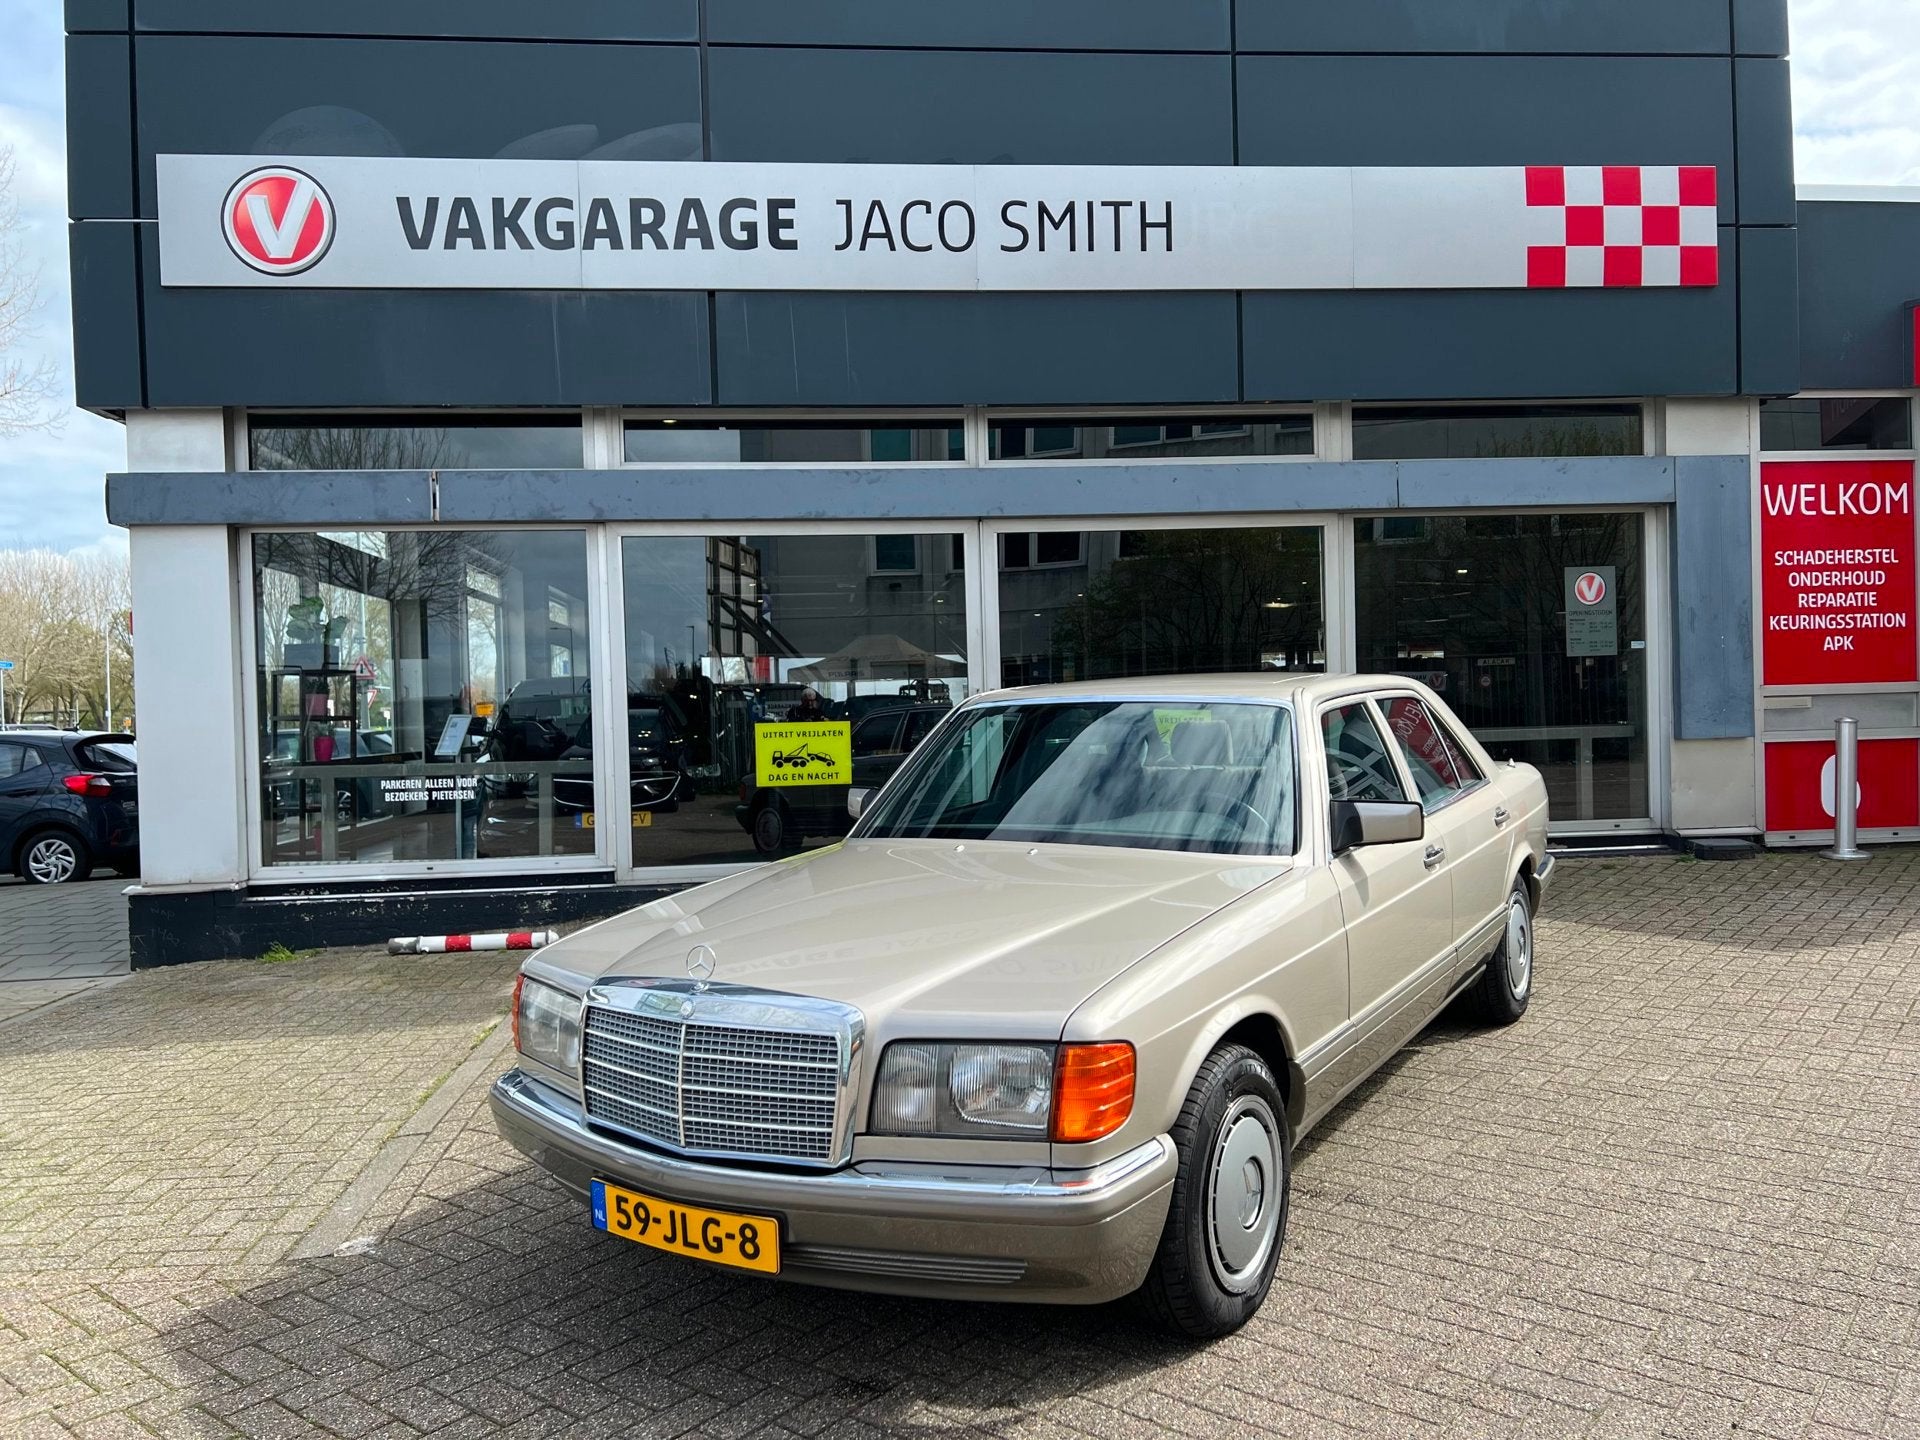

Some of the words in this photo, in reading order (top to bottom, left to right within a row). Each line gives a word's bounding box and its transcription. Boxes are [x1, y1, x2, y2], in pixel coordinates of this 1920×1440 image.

[396, 196, 798, 251] VAKGARAGE
[834, 199, 976, 252] JACO
[1000, 200, 1173, 252] SMITH
[1763, 482, 1909, 516] WELKOM
[1774, 549, 1899, 566] SCHADEHERSTEL
[1788, 570, 1886, 587] ONDERHOUD
[1798, 592, 1878, 608] REPARATIE
[1769, 612, 1907, 630] KEURINGSSTATION
[1823, 635, 1854, 651] APK
[762, 731, 794, 739] UITRIT
[796, 730, 844, 738] VRIJLATEN
[380, 779, 422, 790] PARKEREN
[425, 778, 454, 789] ALLEEN
[456, 777, 478, 788] VOOR
[768, 773, 788, 782] DAG
[791, 773, 804, 781] EN
[807, 771, 840, 780] NACHT
[384, 791, 429, 802] BEZOEKERS
[431, 790, 475, 801] PIETERSEN
[594, 1209, 606, 1222] NL
[615, 1194, 761, 1260] 59-JLG-8
